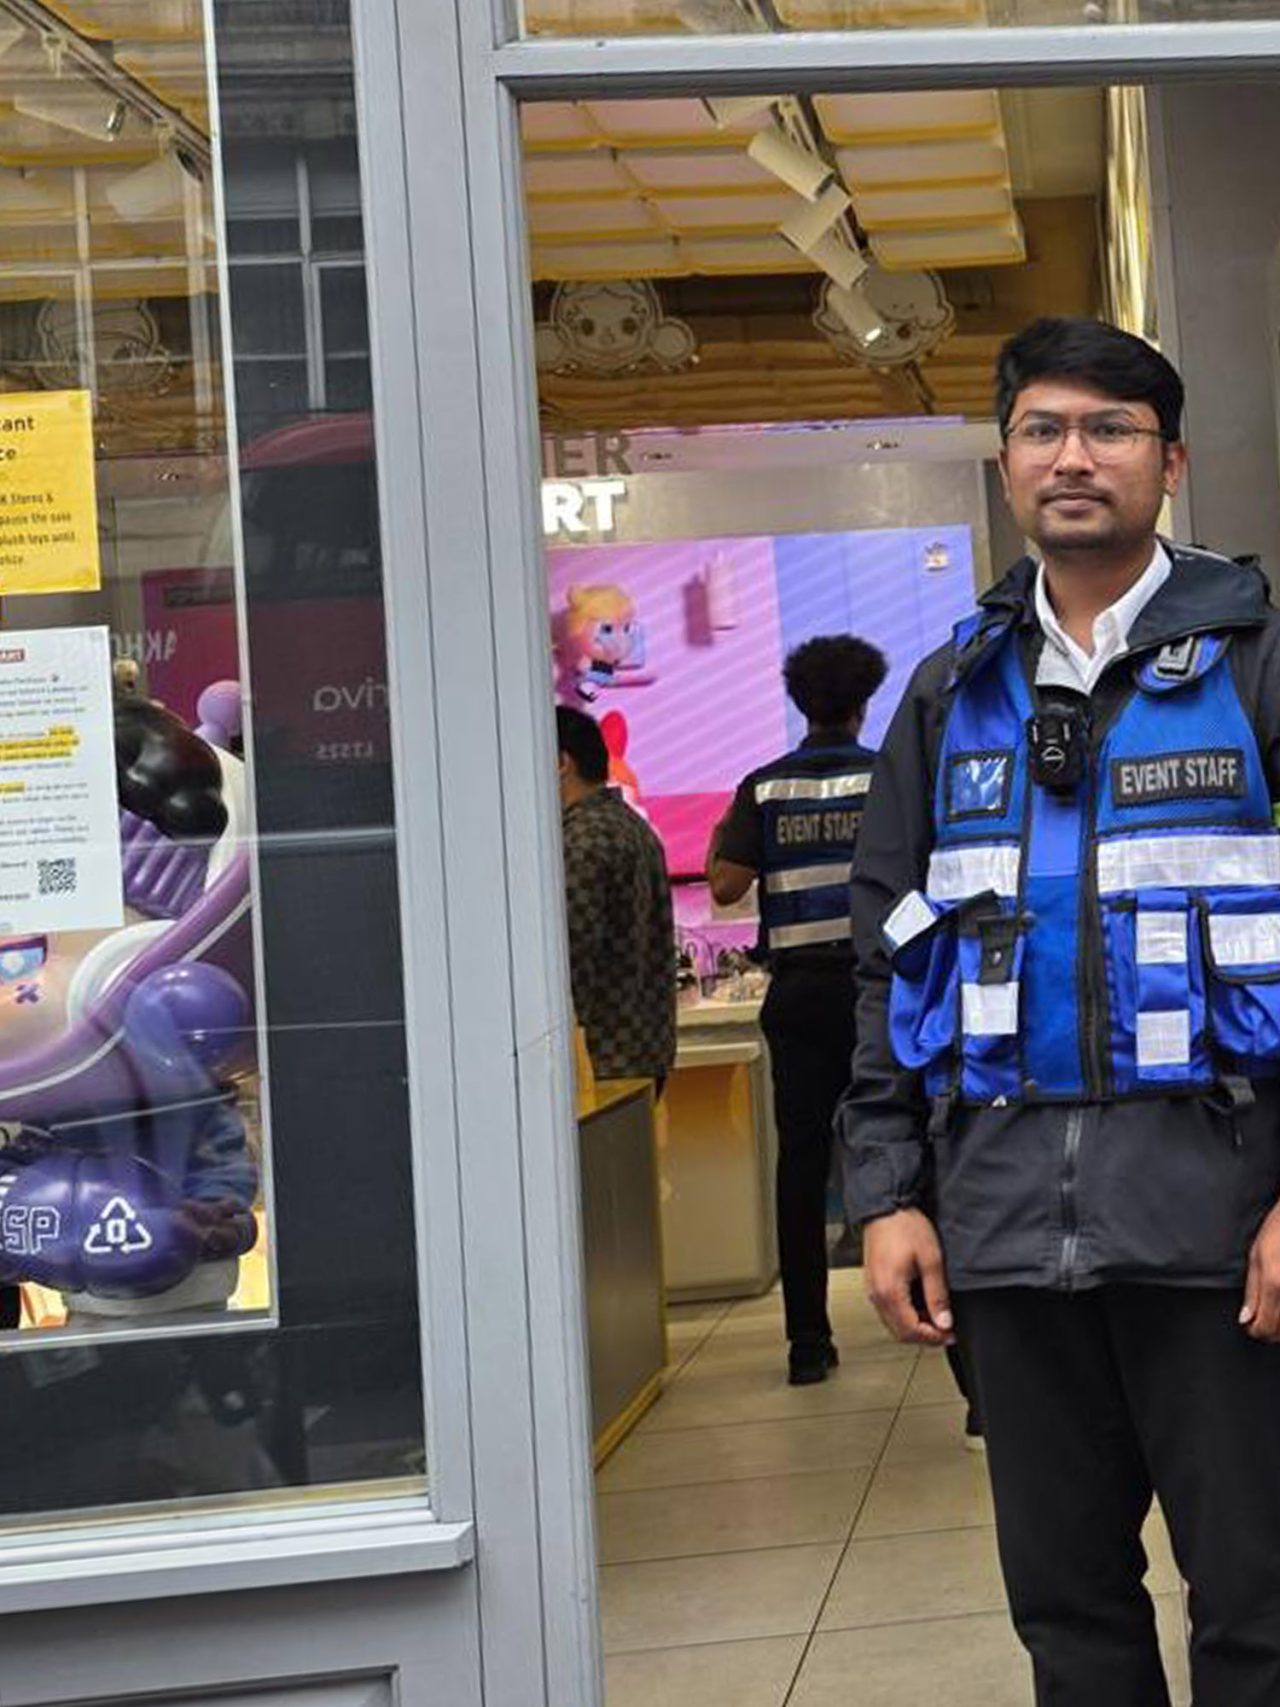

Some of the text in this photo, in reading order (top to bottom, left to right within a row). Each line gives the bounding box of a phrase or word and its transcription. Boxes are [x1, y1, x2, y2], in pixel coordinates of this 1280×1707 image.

[0, 415, 34, 432] ant
[541, 480, 627, 536] RT
[1120, 757, 1237, 795] EVENT STAFF
[777, 811, 864, 844] EVENT STAF
